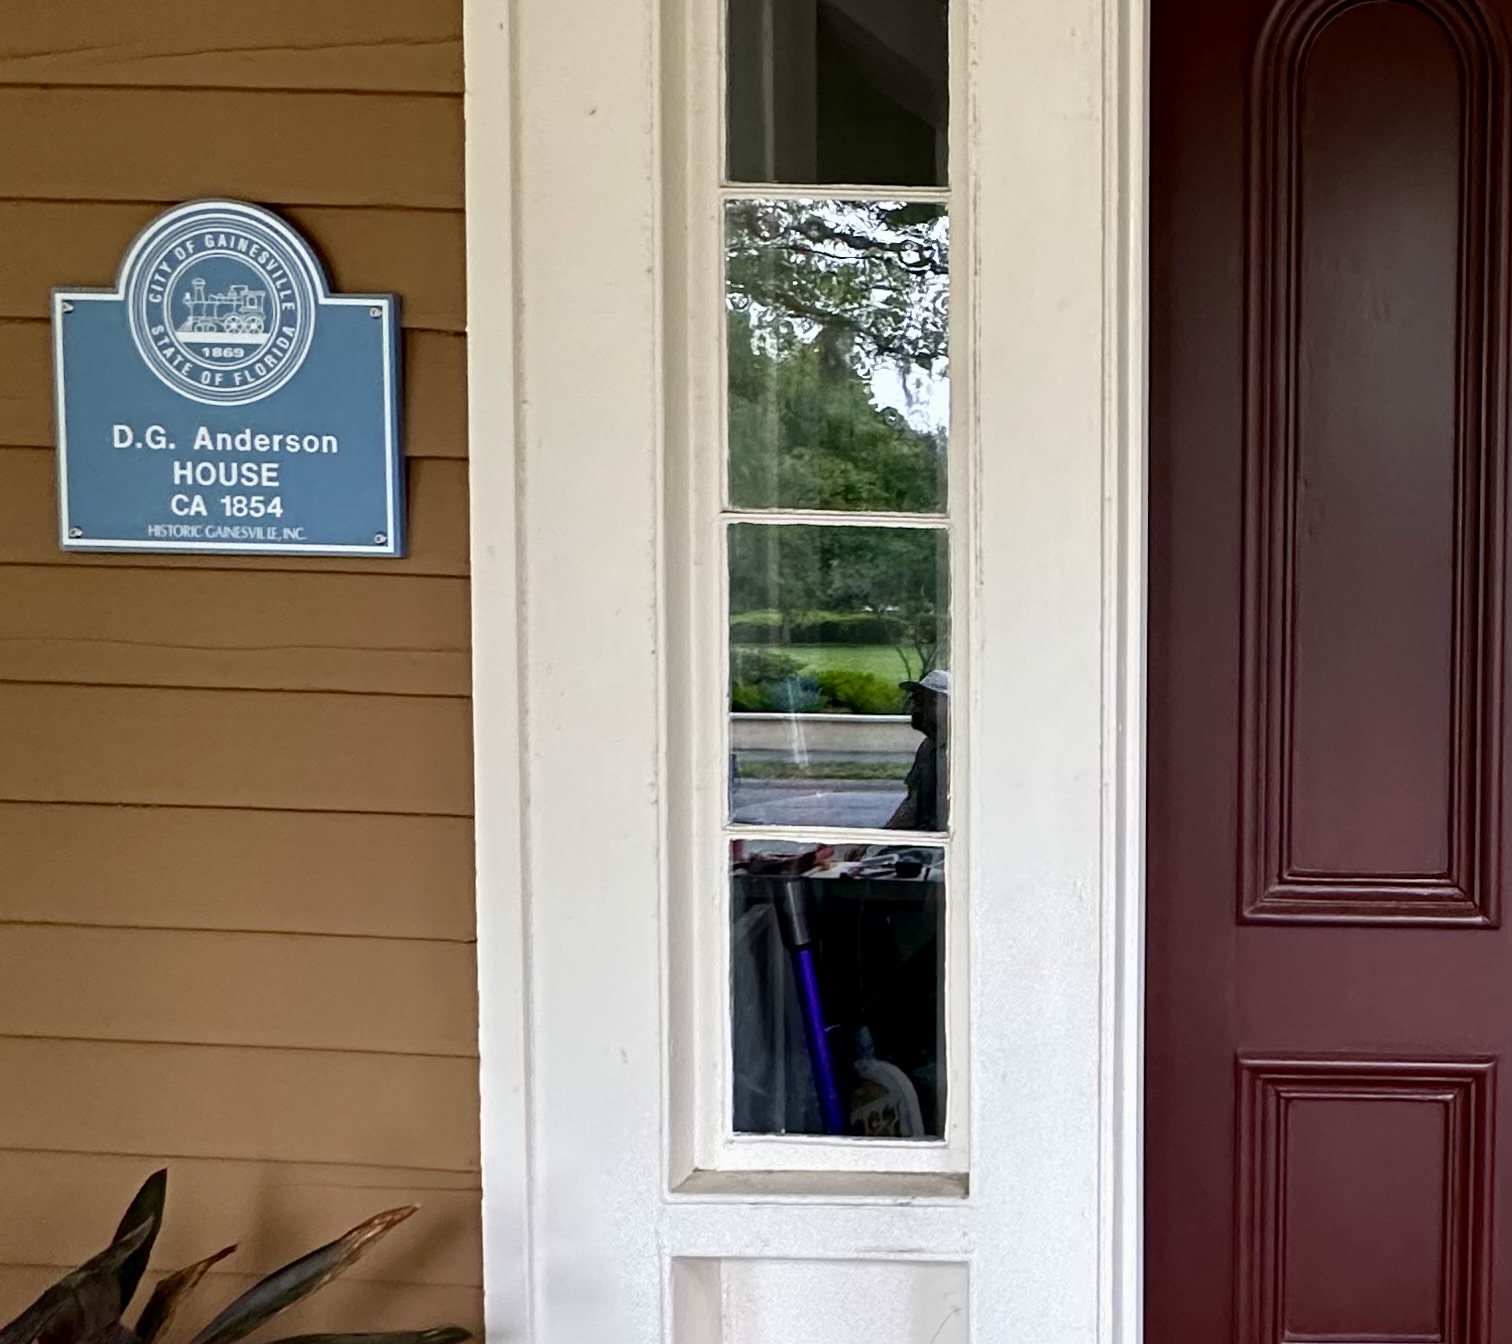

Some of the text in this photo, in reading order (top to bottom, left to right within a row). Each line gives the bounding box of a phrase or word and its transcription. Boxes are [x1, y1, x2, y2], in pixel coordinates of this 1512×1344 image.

[150, 233, 296, 311] CITY OF GAINESVILLE
[151, 324, 296, 386] STATE OF FLORIDA
[201, 346, 245, 358] 1869
[112, 424, 338, 454] D.G. Anderson
[173, 460, 280, 488] HOUSE
[170, 494, 283, 519] CA 1854
[147, 524, 202, 539] HISTORIC
